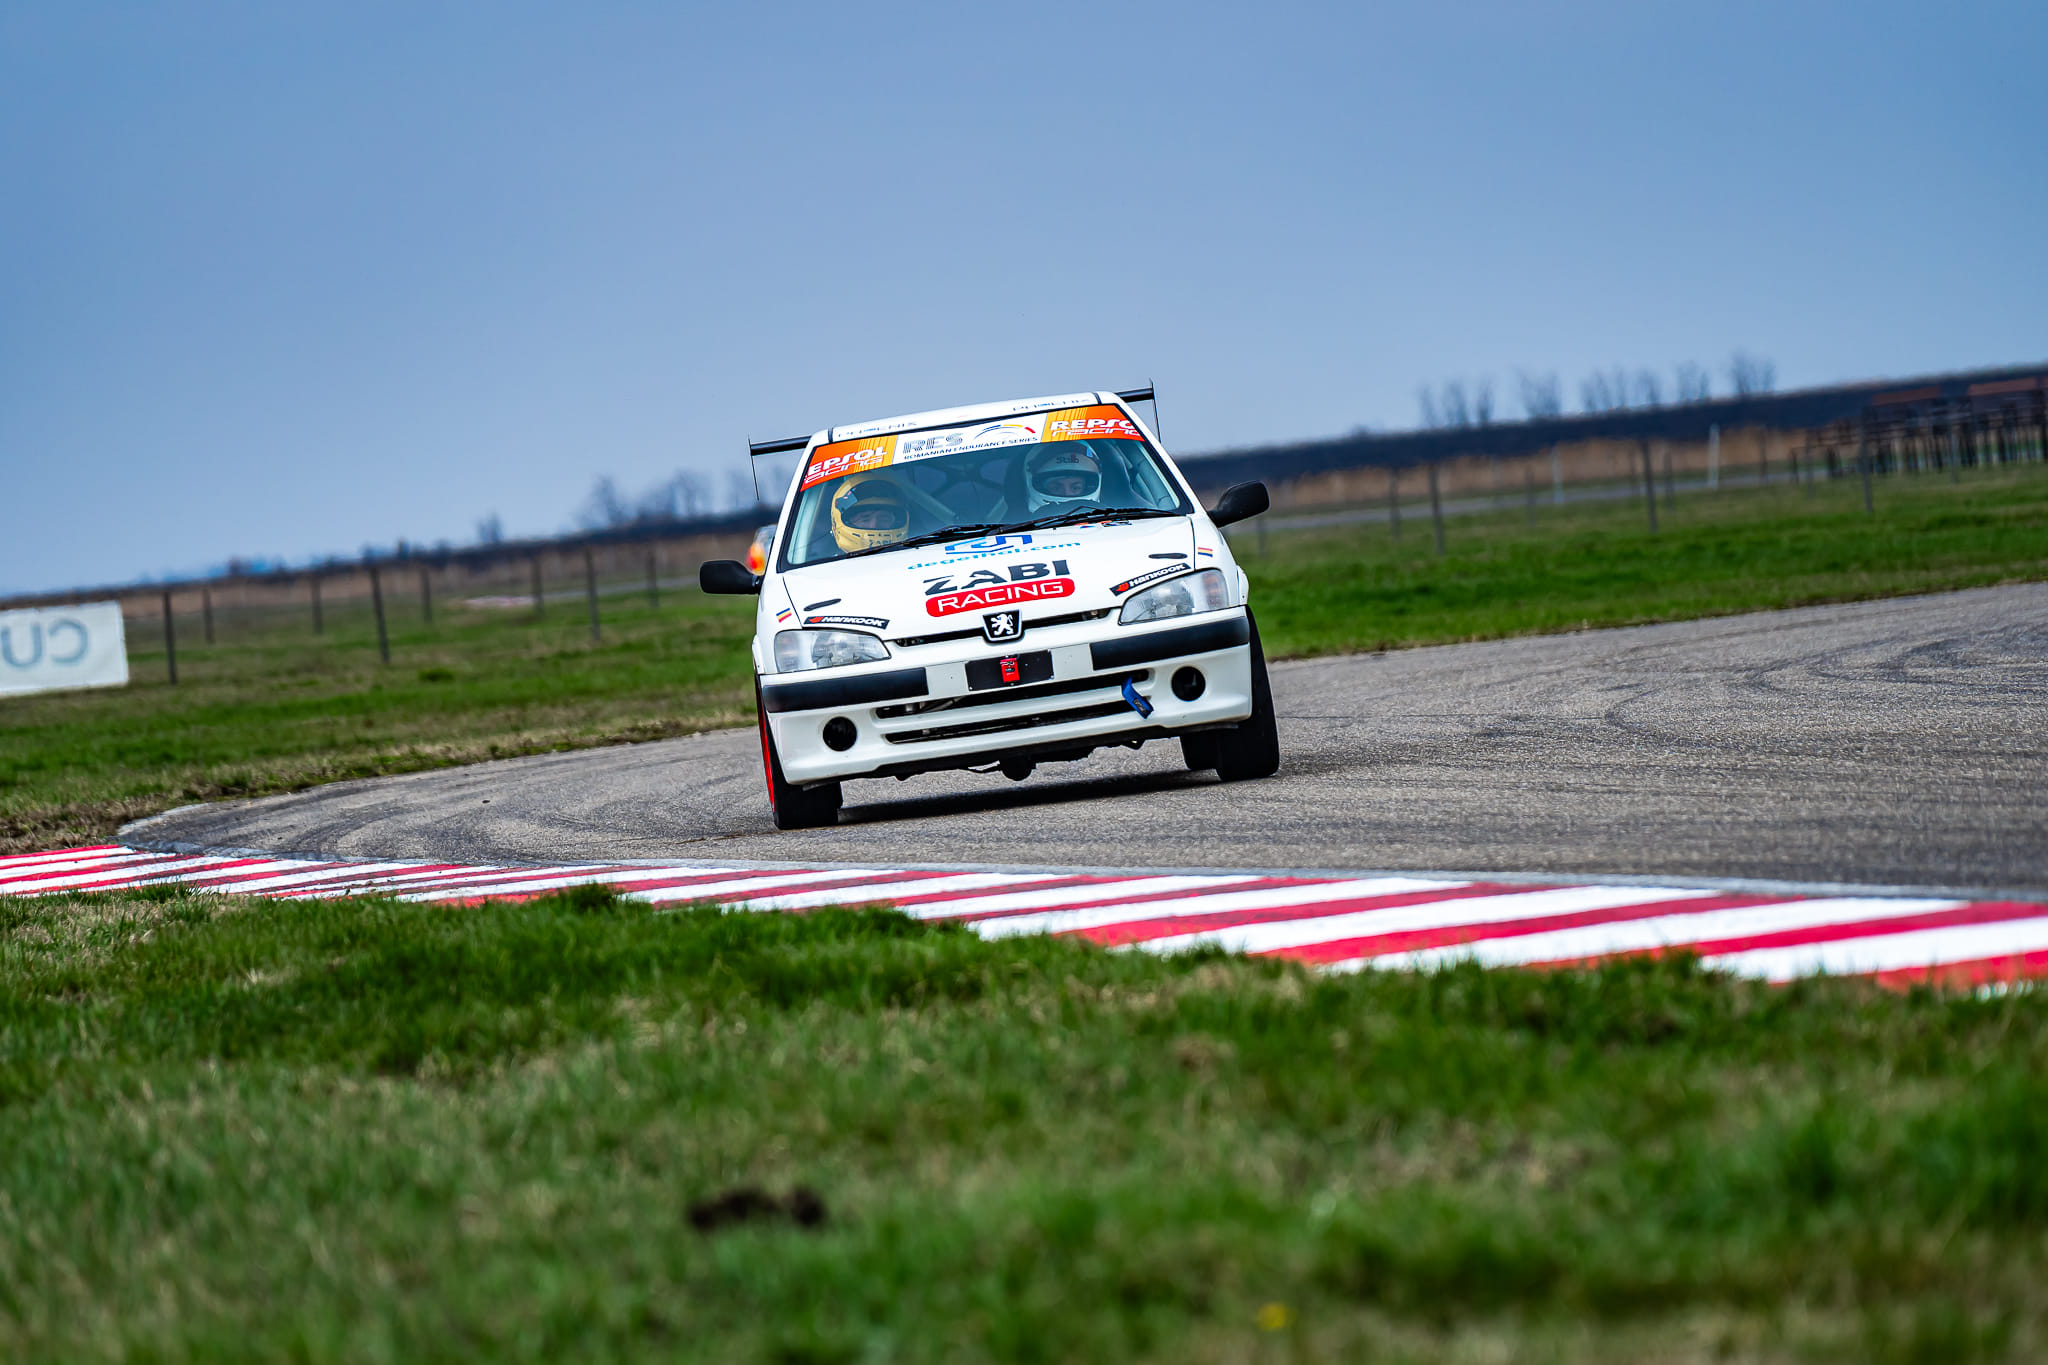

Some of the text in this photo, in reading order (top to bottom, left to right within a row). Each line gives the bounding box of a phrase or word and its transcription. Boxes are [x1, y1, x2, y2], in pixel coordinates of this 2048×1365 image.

[806, 446, 888, 477] EPSOL
[904, 437, 1038, 460] ROMANIAN ENDURANCE SERIES
[803, 456, 884, 484] acing
[923, 559, 1071, 597] ZABI
[937, 581, 1064, 613] RACING
